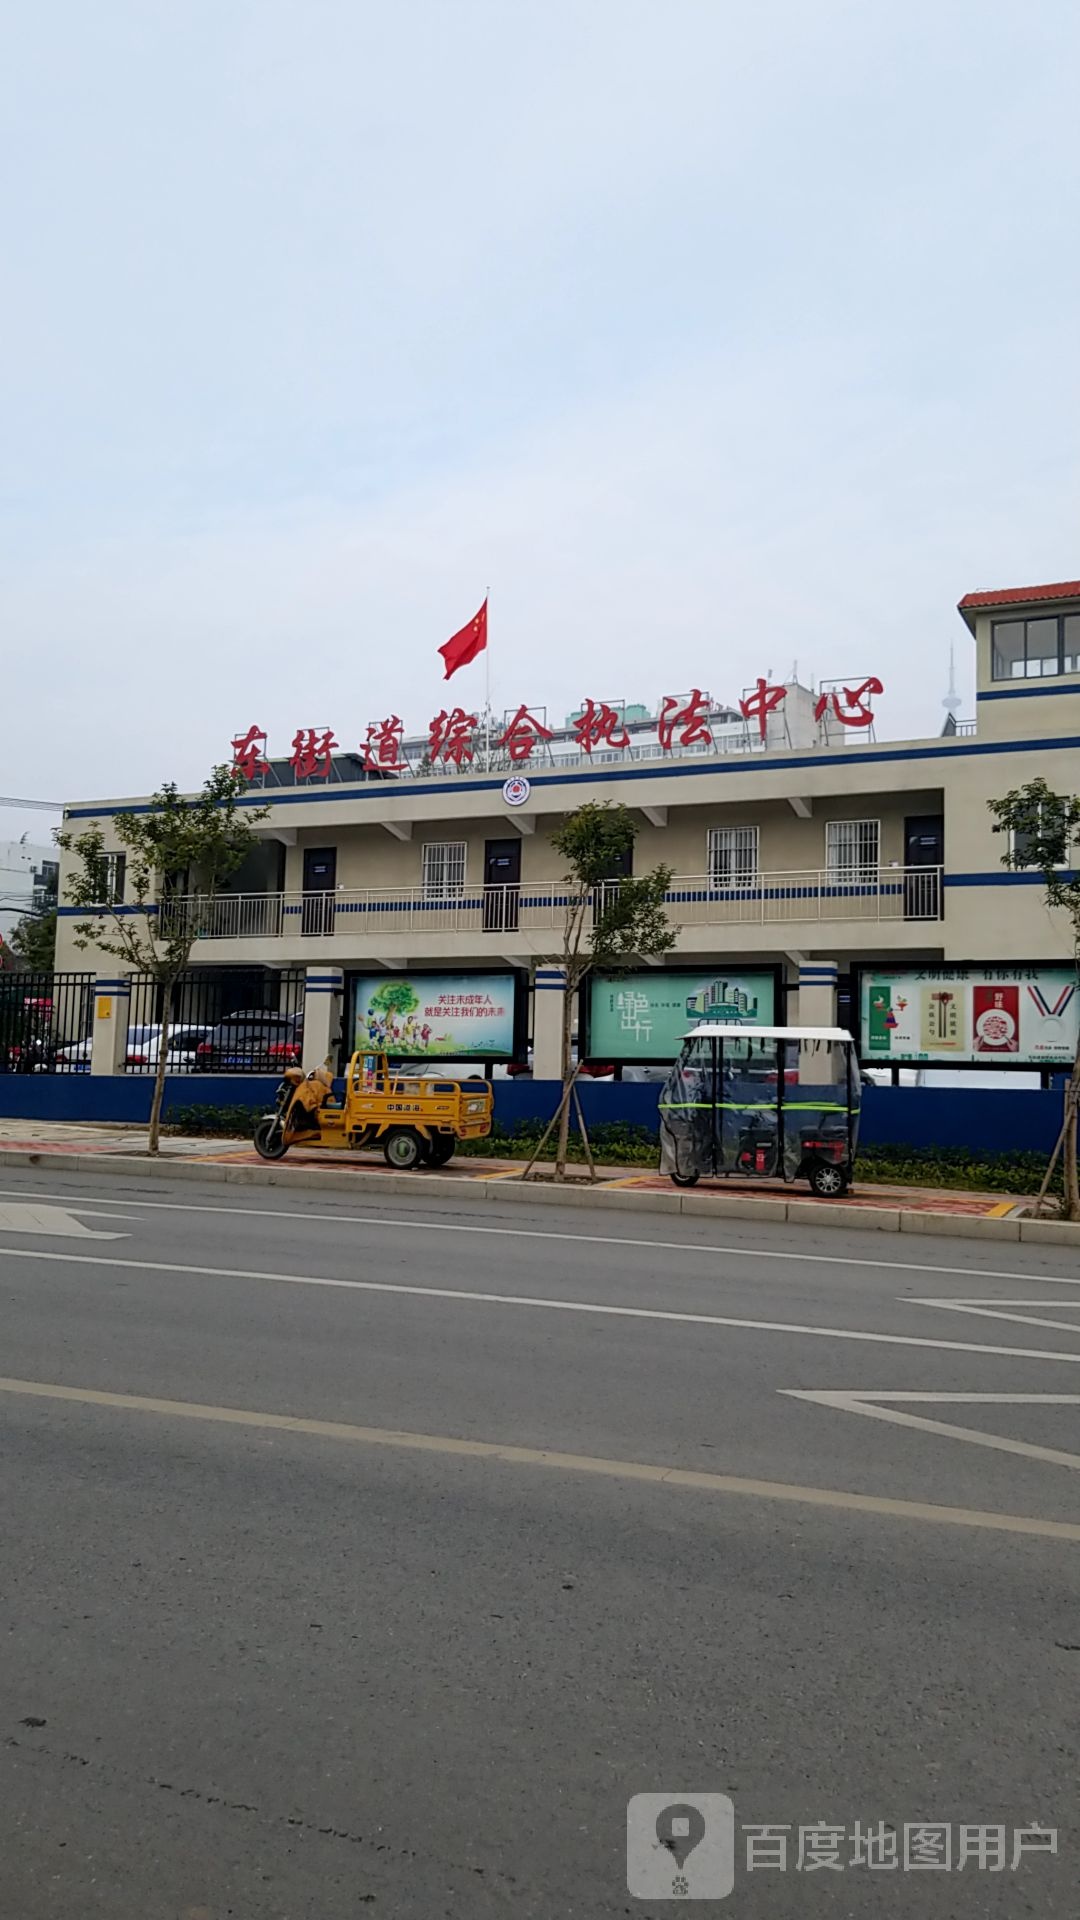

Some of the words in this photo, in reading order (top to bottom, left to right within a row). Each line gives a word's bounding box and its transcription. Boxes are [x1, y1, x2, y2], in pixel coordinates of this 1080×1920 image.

[438, 994, 492, 1005] 关注未成年人
[424, 1006, 505, 1017] 就是关注我们的未来
